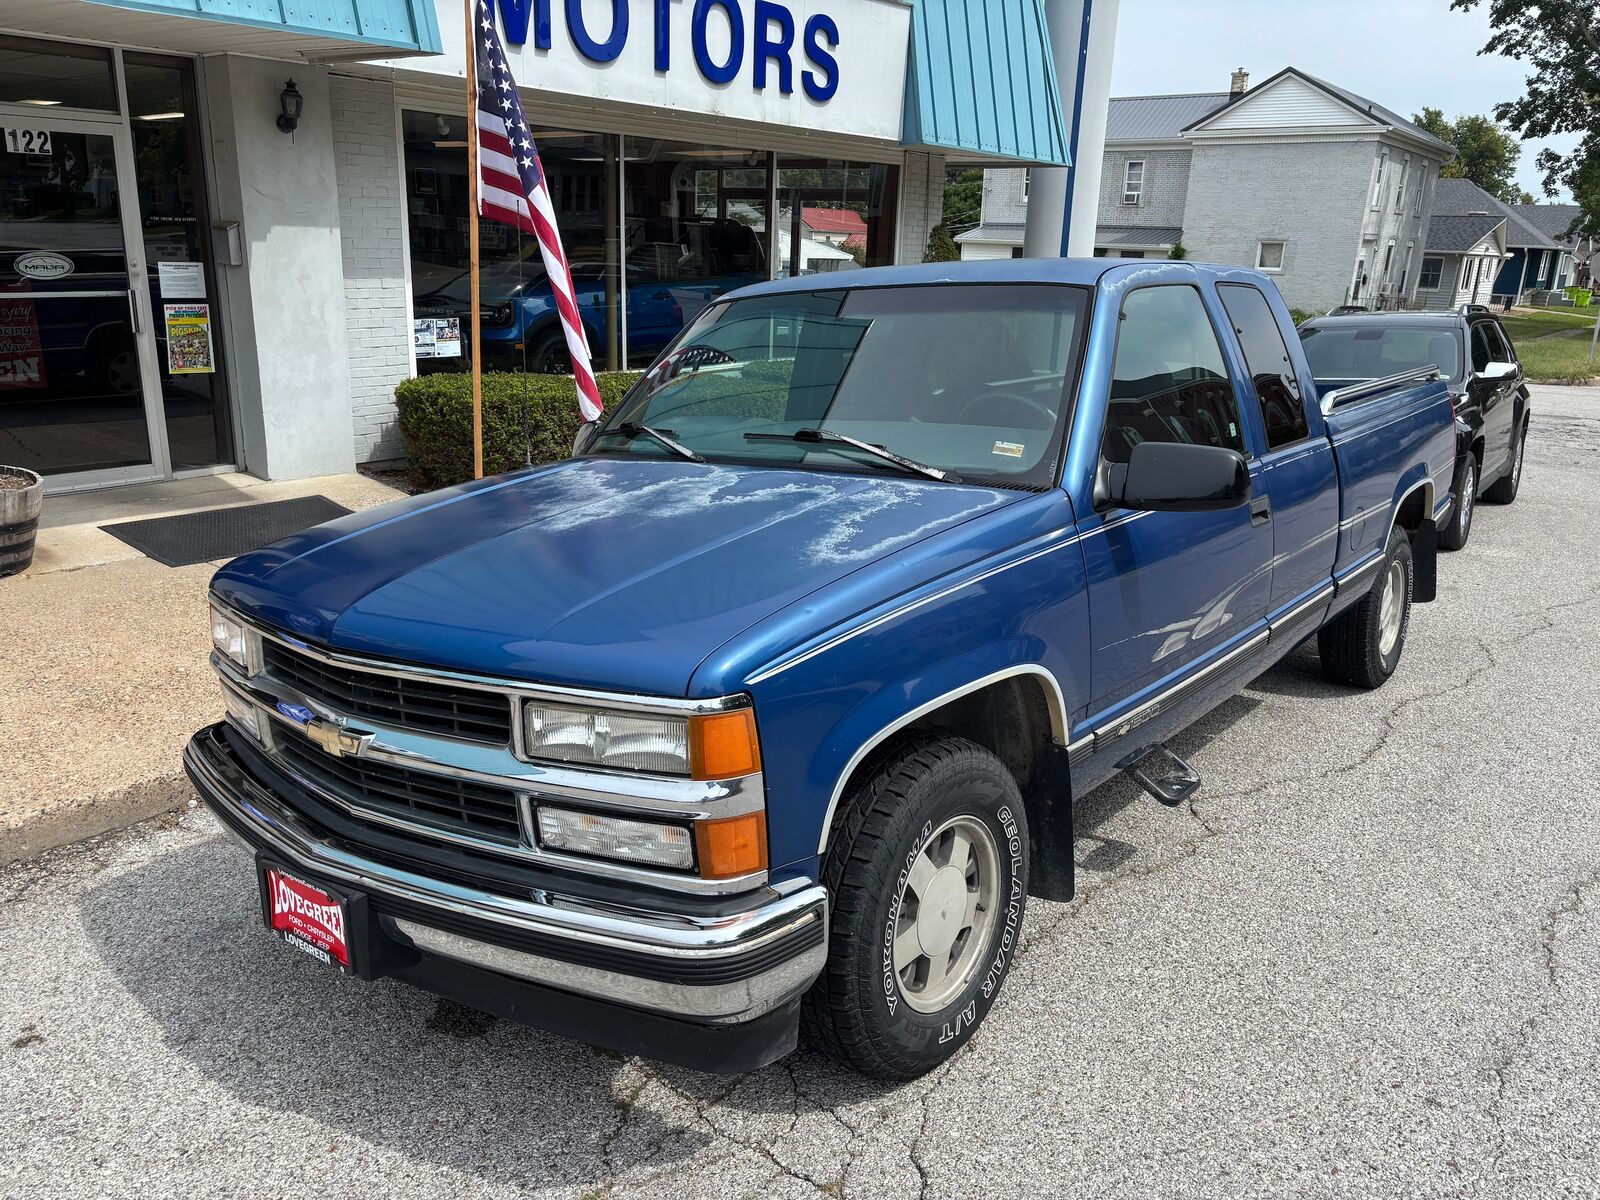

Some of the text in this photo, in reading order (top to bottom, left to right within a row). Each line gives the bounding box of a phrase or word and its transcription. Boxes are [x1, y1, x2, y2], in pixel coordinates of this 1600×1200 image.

[8, 129, 51, 154] 122
[171, 326, 201, 336] PIGSKIN
[288, 914, 335, 944] FORD CHRYSLER
[883, 820, 932, 1016] YOKOHAMA
[938, 805, 1022, 1044] GEOLANDAR A/T
[284, 931, 331, 965] LOVEGREEN
[293, 927, 330, 950] DODGE JEEP
